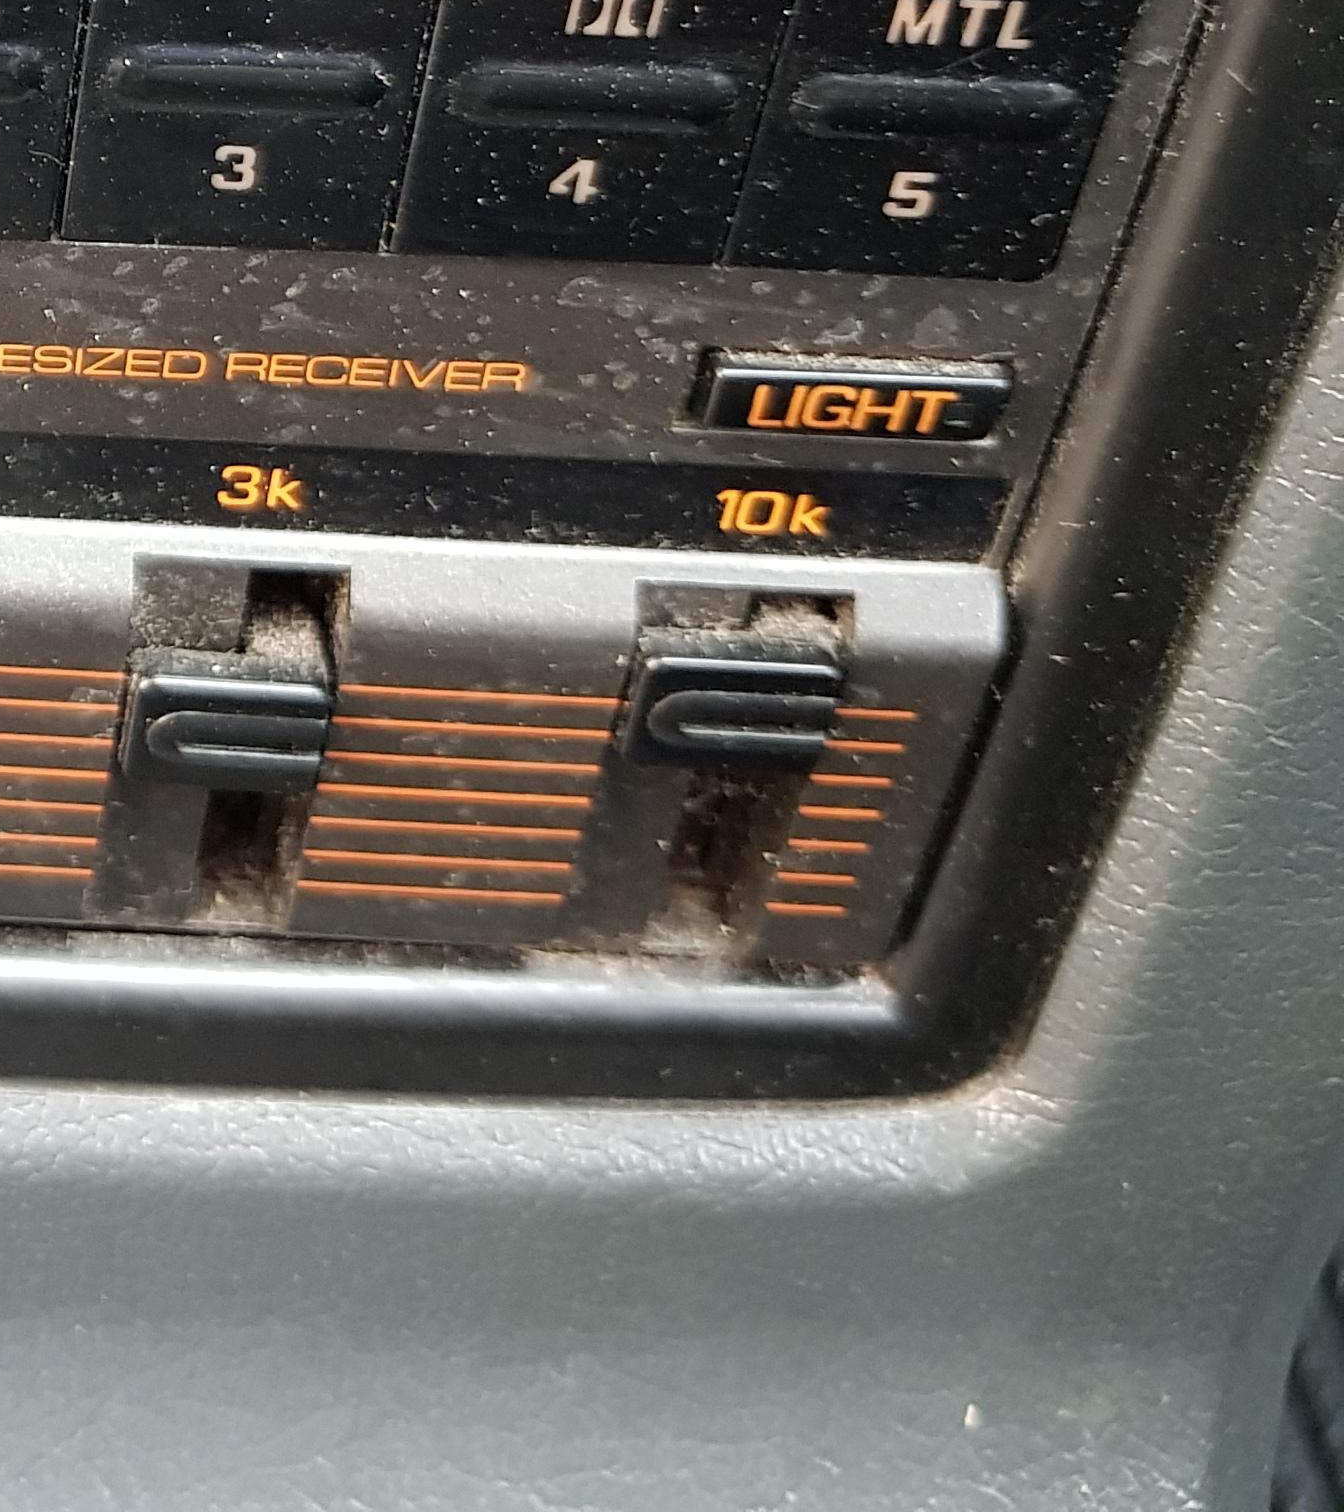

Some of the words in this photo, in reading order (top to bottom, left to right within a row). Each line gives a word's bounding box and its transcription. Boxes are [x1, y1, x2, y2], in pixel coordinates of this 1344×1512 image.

[210, 144, 260, 194] 3
[548, 158, 602, 206] 4
[884, 173, 934, 219] 5
[224, 350, 532, 394] RECEIVER
[746, 384, 960, 436] LIGHT
[216, 464, 302, 514] 3k
[714, 488, 830, 542] 10k
